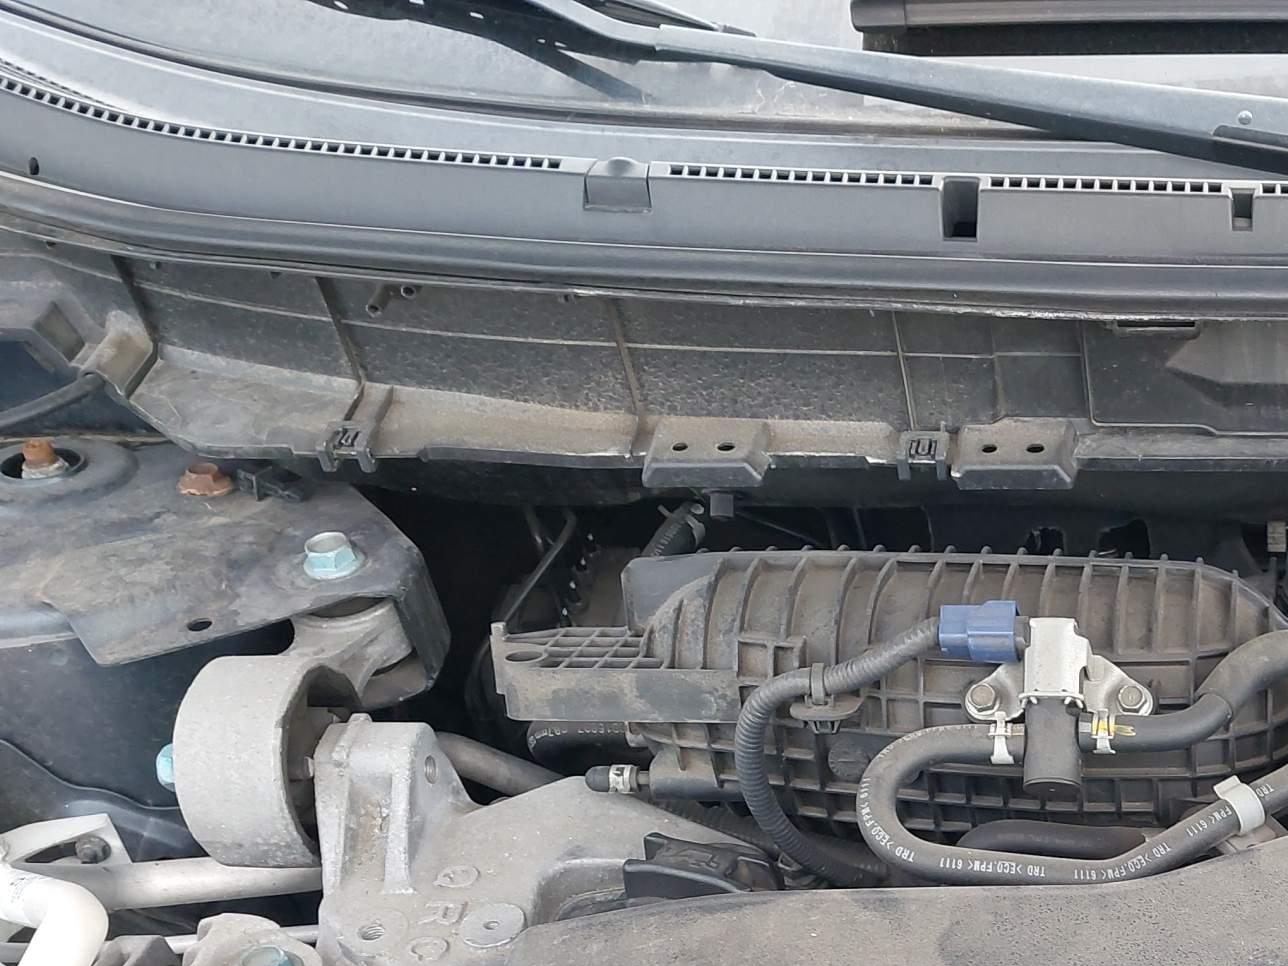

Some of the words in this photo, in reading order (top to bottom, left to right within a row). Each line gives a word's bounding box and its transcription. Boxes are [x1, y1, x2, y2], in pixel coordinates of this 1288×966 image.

[1256, 783, 1274, 799] TRD
[895, 846, 915, 863] TRD
[1152, 843, 1171, 858] TRD
[939, 857, 963, 870] 6111
[1027, 865, 1046, 877] TRD
[1073, 869, 1096, 881] 6111
